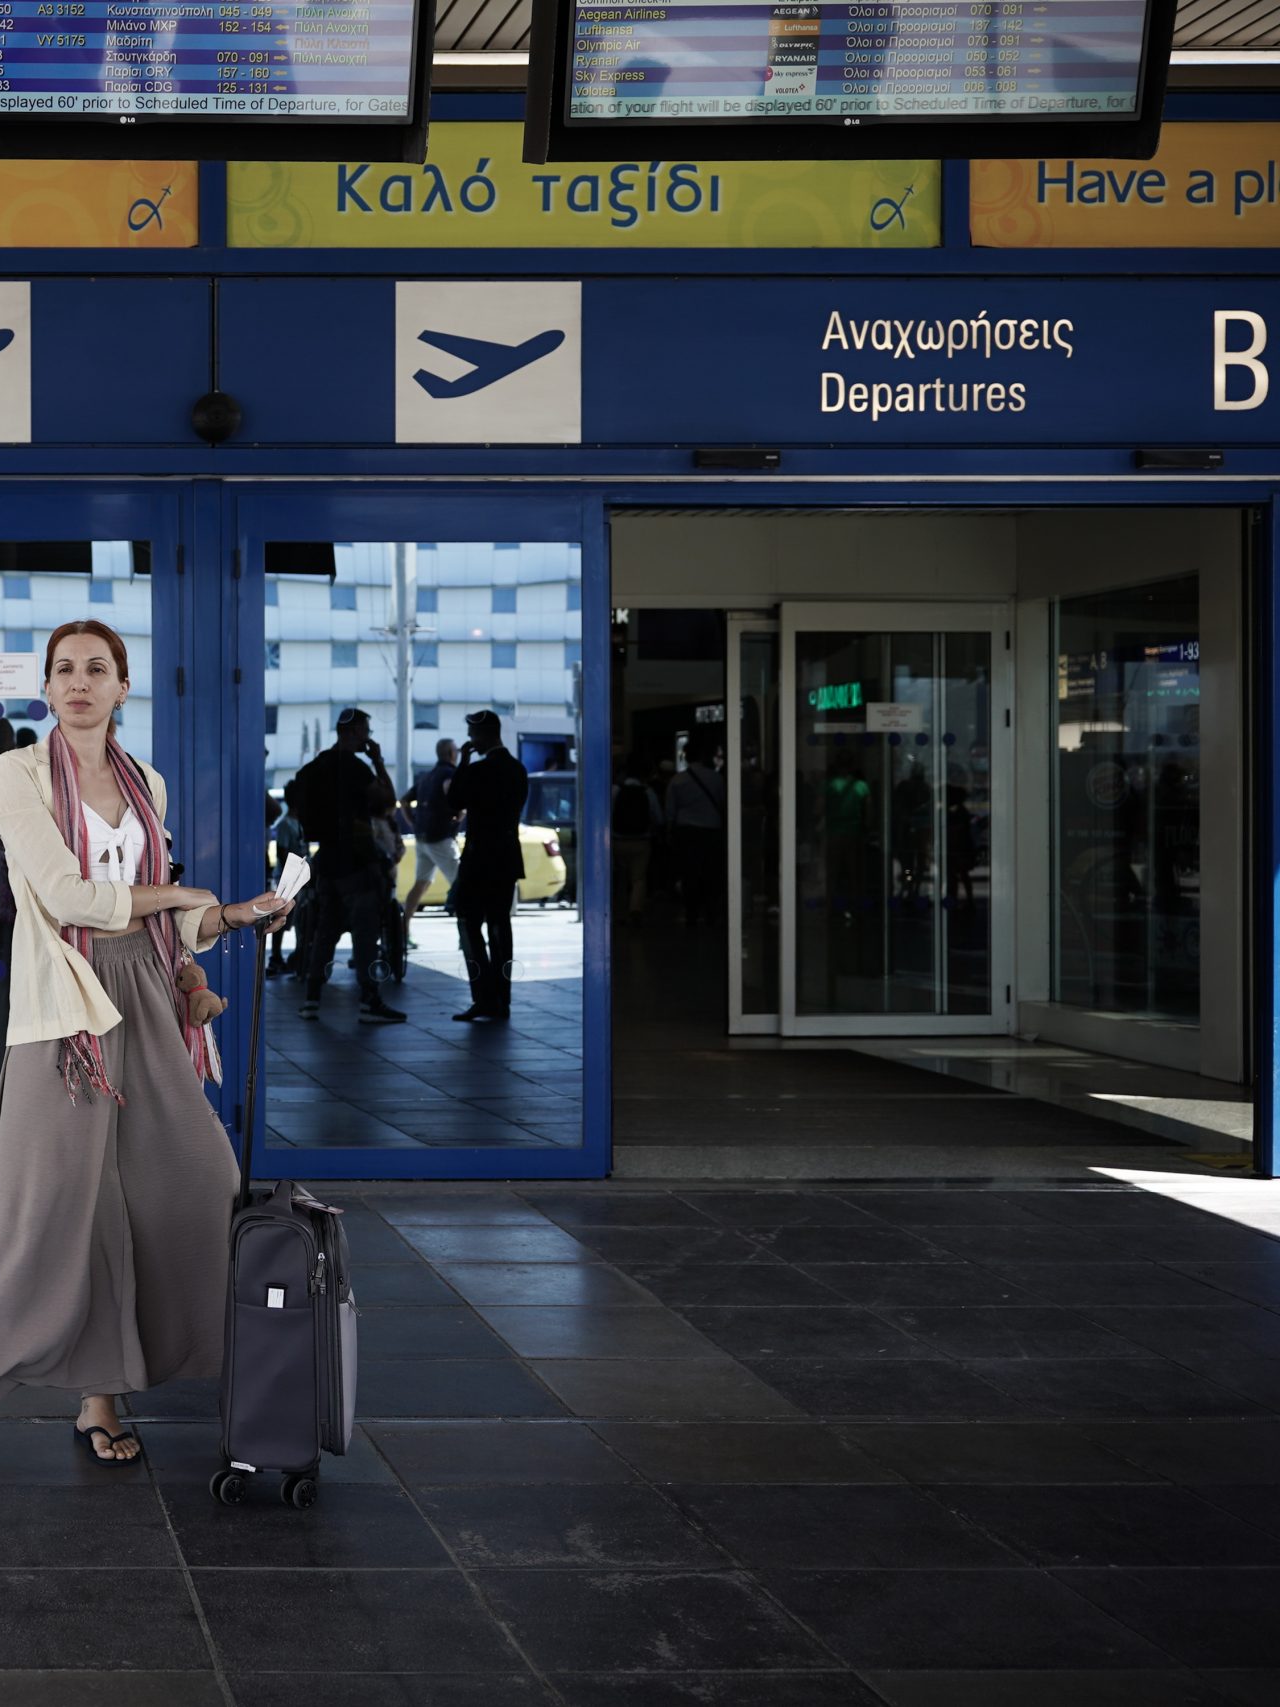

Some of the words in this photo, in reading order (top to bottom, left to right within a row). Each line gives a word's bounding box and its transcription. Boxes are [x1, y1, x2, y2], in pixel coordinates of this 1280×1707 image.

[37, 4, 53, 15] A3
[57, 4, 84, 15] 3152
[107, 4, 213, 18] Κωνσταντινούπολη
[578, 9, 621, 21] Aegean
[624, 9, 666, 19] Airlines
[878, 8, 888, 17] οι
[970, 4, 992, 15] 070
[1002, 4, 1023, 15] 091
[106, 20, 146, 31] Μιλάνο
[150, 20, 177, 31] MXP
[219, 22, 239, 32] 152
[251, 22, 272, 32] 154
[294, 22, 323, 34] Πύλη
[577, 25, 632, 35] Lufthansa
[876, 24, 887, 32] οι
[36, 35, 53, 46] VY
[57, 35, 85, 46] 5175
[106, 35, 153, 48] Μαδρίτη
[576, 40, 621, 52] Olympic
[625, 40, 640, 50] Air
[875, 39, 885, 47] οι
[967, 35, 989, 46] 070
[1000, 35, 1020, 46] 091
[217, 52, 238, 63] 070
[248, 53, 269, 63] 091
[576, 56, 620, 68] Ryanair
[874, 54, 884, 63] οι
[105, 66, 141, 78] Παρίσι
[145, 67, 172, 77] ORY
[217, 67, 238, 78] 157
[249, 68, 270, 78] 160
[575, 70, 596, 82] Sky
[600, 70, 645, 83] Express
[873, 70, 883, 78] οι
[104, 81, 141, 93] Παρίσι
[145, 82, 173, 92] CDG
[217, 82, 237, 93] 125
[248, 83, 268, 93] 131
[575, 86, 616, 96] Volotea
[872, 85, 882, 94] οι
[58, 96, 78, 108] 60'
[82, 96, 113, 111] prior
[118, 97, 130, 108] to
[135, 96, 208, 110] Scheduled
[213, 97, 246, 110] Time
[250, 98, 264, 110] of
[268, 98, 340, 113] Departure,
[345, 98, 365, 111] for
[368, 99, 408, 112] Gates
[571, 102, 604, 114] ation
[608, 101, 622, 113] of
[626, 103, 656, 116] your
[660, 101, 693, 115] flight
[697, 100, 719, 113] will
[723, 100, 740, 112] be
[745, 99, 811, 114] displayed
[815, 98, 837, 111] 60'
[840, 99, 872, 113] prior
[876, 98, 889, 110] to
[894, 98, 968, 110] Scheduled
[972, 97, 1006, 109] Time
[1010, 97, 1025, 109] of
[1028, 96, 1102, 111] Departure,
[1107, 96, 1126, 108] for
[337, 158, 496, 213] Καλό
[532, 161, 720, 228] ταξίδι
[1038, 160, 1166, 204] Have
[1186, 173, 1215, 204] a
[1234, 160, 1280, 217] pl
[822, 310, 1073, 359] Αναχωρήσεις
[1213, 310, 1270, 411] B
[821, 372, 1026, 422] Departures
